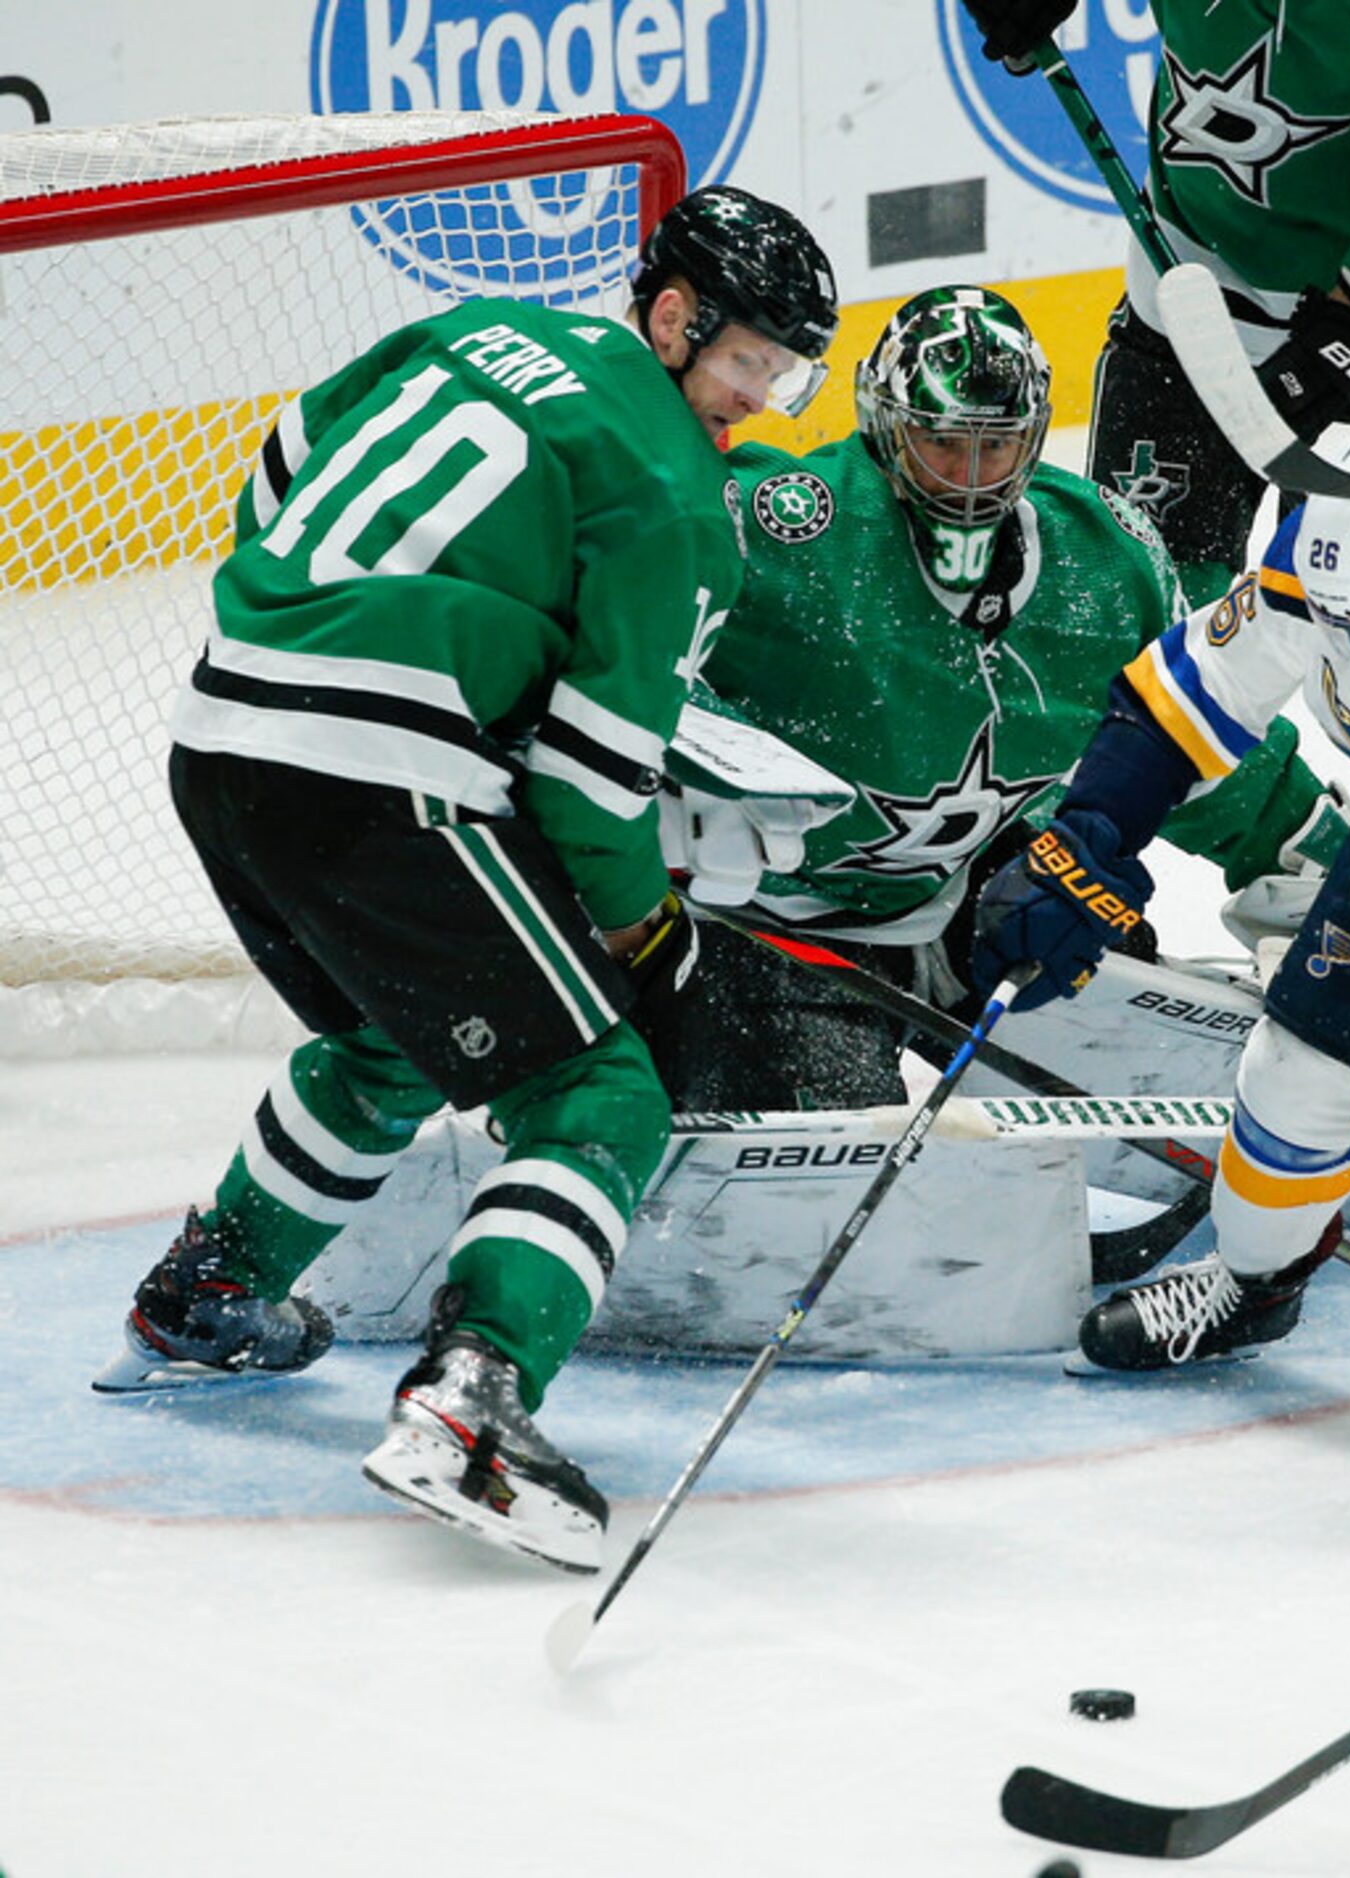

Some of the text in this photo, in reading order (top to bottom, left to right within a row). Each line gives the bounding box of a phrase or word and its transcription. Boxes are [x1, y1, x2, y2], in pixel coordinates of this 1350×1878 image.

[368, 0, 728, 205] Kroger
[449, 324, 587, 406] PERRY
[261, 363, 528, 586] 10
[933, 528, 994, 581] 30
[1309, 538, 1341, 572] 26
[982, 1100, 1231, 1126] WARRIO
